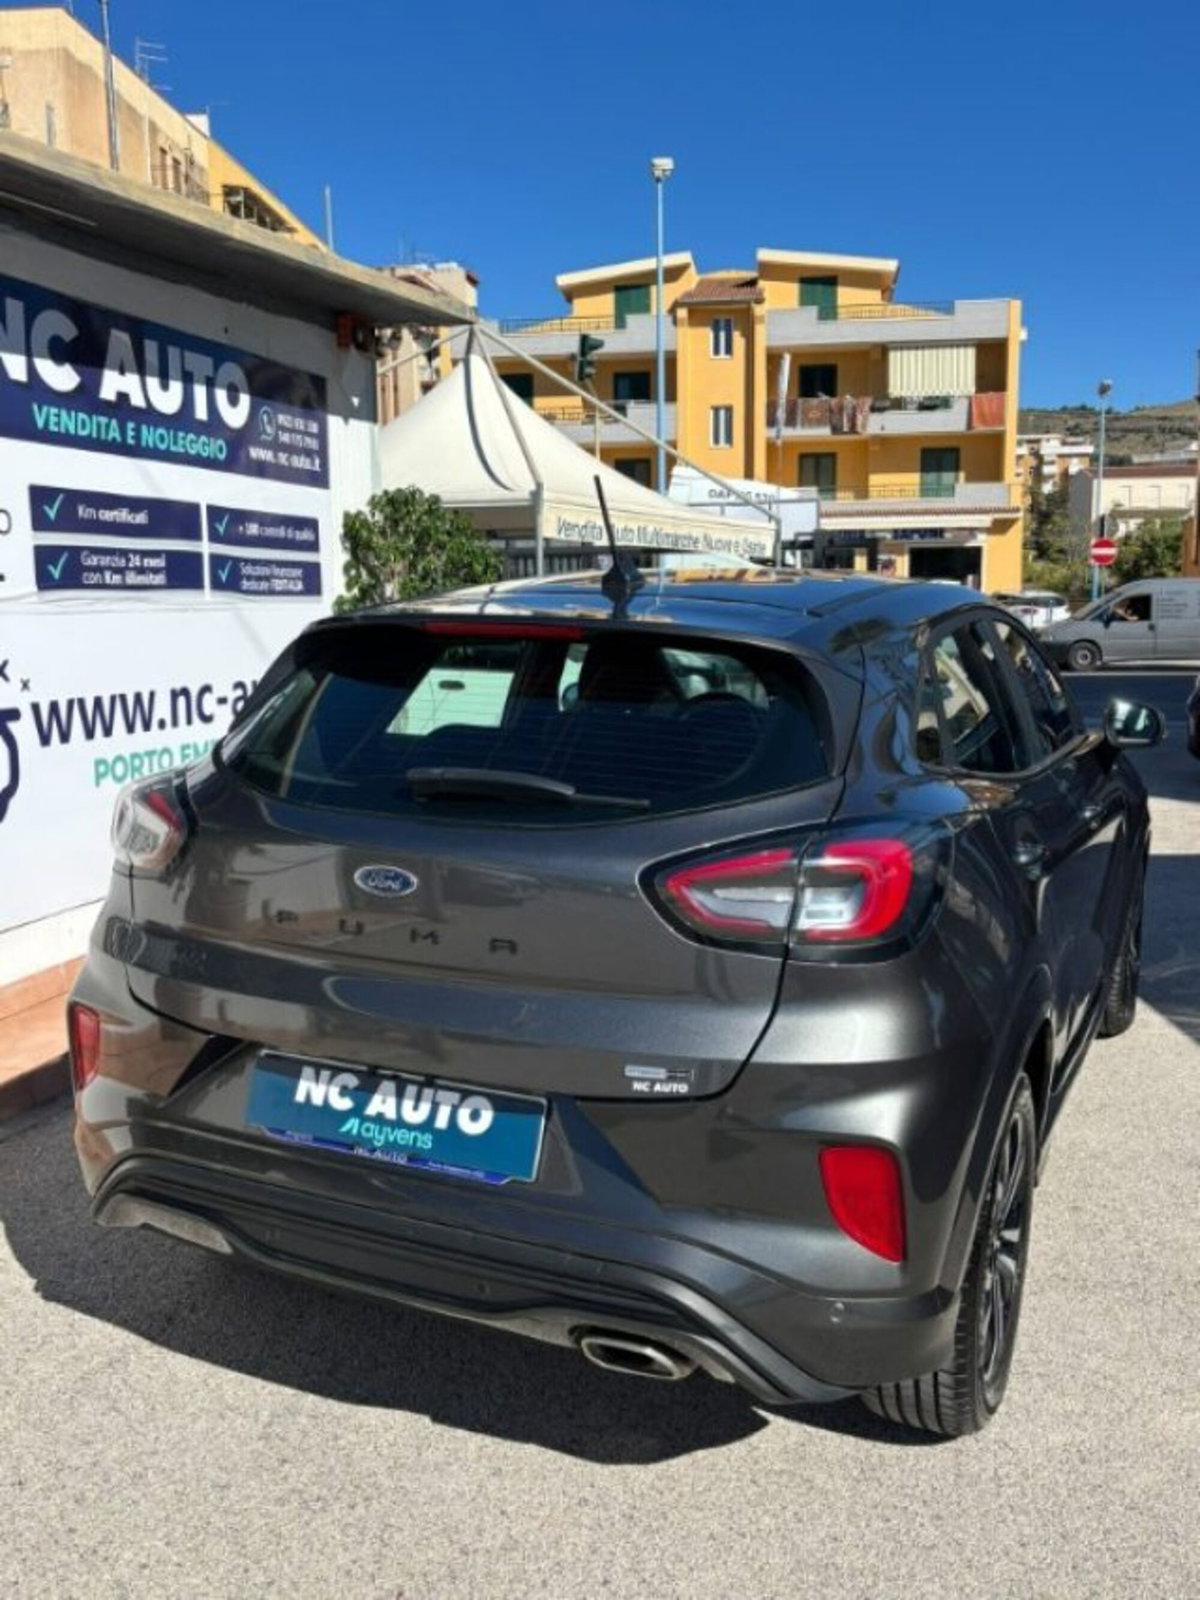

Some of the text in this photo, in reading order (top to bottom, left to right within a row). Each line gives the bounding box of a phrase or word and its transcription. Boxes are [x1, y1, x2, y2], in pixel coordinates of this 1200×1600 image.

[0, 297, 251, 429] NC AUTO
[33, 403, 227, 460] VENDITA E NOLEGGIO
[77, 504, 148, 525] Km certificati
[557, 516, 603, 541] Vendita
[609, 522, 635, 542] uto
[80, 551, 166, 568] Garanzia 24 mesi
[82, 570, 167, 586] con Km illimitati
[31, 678, 258, 747] www.nc-a
[94, 738, 216, 787] PORTO EM
[367, 871, 405, 892] Ford
[275, 909, 518, 956] PUMA
[294, 1065, 495, 1136] NC AUTO
[632, 1080, 689, 1094] NC AUTO
[360, 1121, 433, 1149] ayvens
